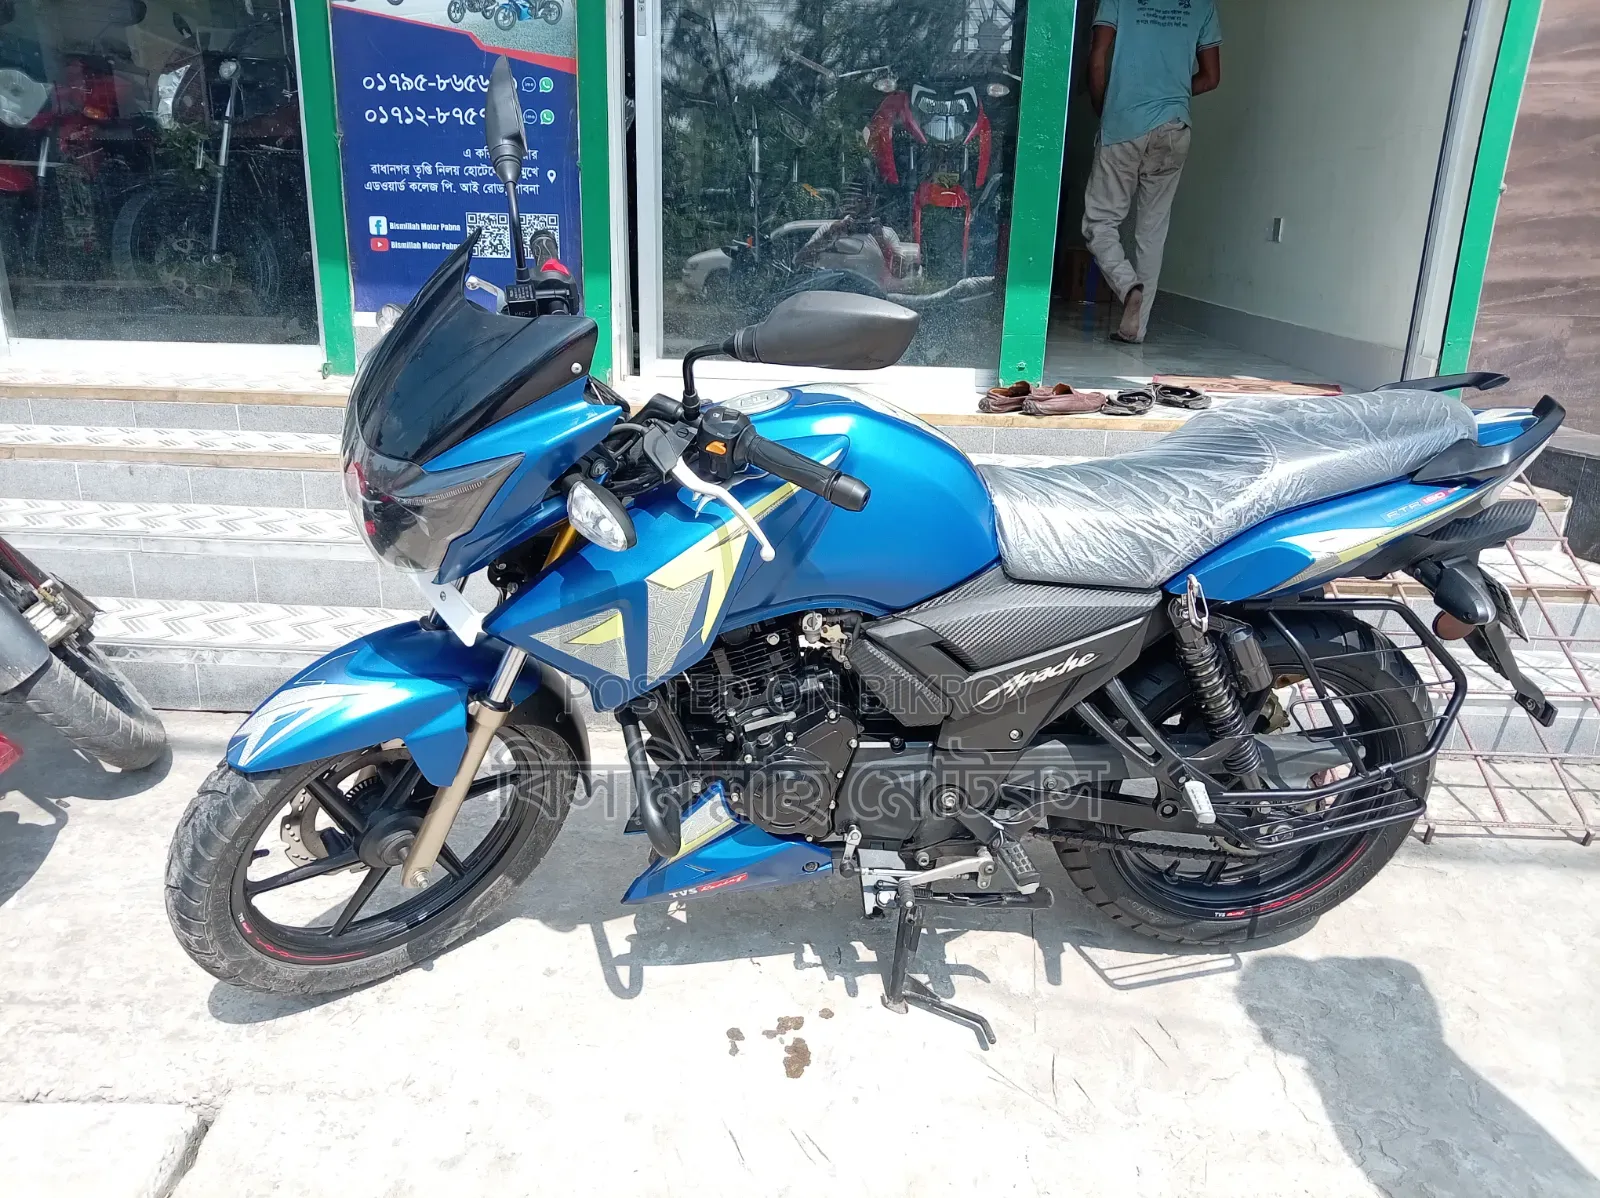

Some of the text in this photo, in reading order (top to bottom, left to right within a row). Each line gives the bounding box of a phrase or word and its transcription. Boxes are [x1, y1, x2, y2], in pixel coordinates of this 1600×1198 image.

[362, 72, 517, 93] ০১৭৯৫-৮৬৫৬
[364, 105, 486, 127] ০১৭১২-৮৭৫
[369, 164, 410, 175] রাধানগর
[435, 162, 460, 176] নিলয়
[408, 182, 438, 192] কলেজ
[459, 180, 480, 194] আই
[389, 222, 461, 231] Bismillah Motor Pabna
[390, 241, 421, 249] Bismillah
[422, 241, 441, 249] Motor
[1386, 501, 1422, 519] RTR
[972, 650, 1101, 708] Apache
[669, 887, 698, 898] TVS
